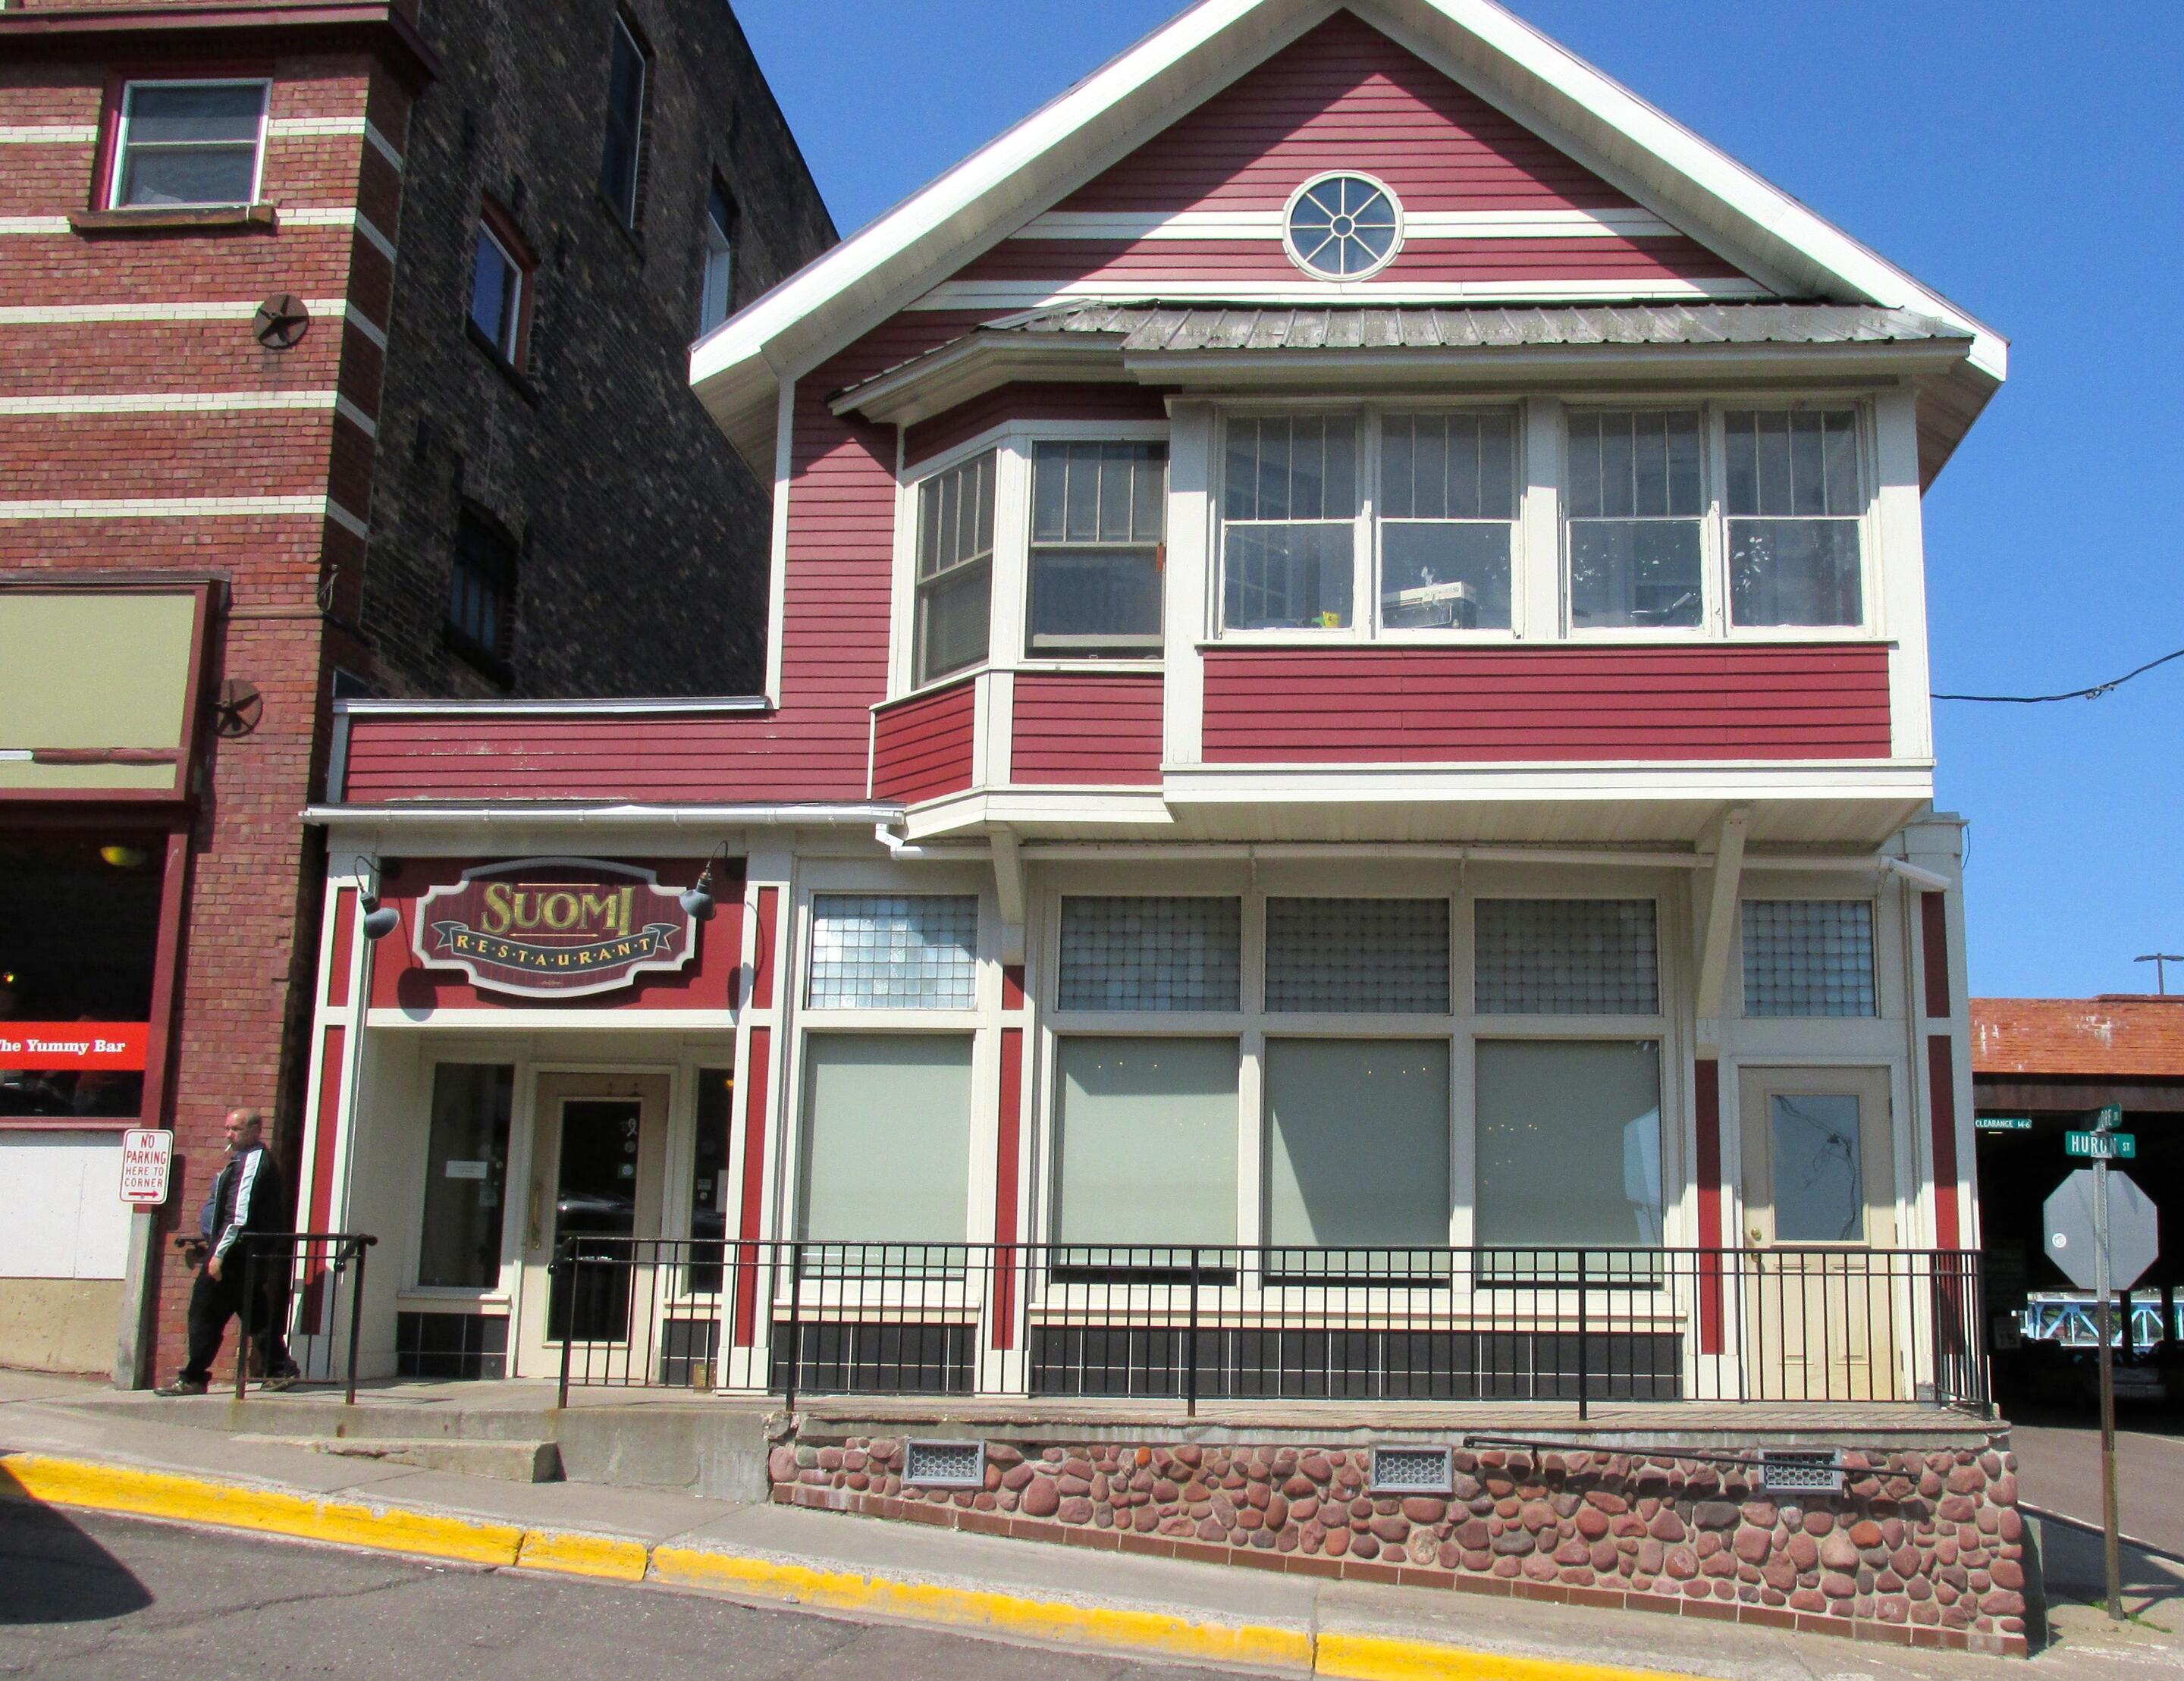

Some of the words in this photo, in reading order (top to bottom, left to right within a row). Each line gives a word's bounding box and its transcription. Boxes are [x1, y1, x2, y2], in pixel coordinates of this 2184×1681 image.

[481, 881, 635, 939] SUOMI
[26, 1039, 89, 1055] Yummy
[93, 1040, 125, 1052] Bar
[1975, 1119, 2014, 1128] CLEARANCE
[140, 1134, 155, 1148] NO
[2123, 1142, 2130, 1152] ST
[126, 1150, 167, 1165] PARKING
[125, 1166, 149, 1176] HERE
[153, 1166, 165, 1177] TO
[124, 1178, 163, 1188] CORNER
